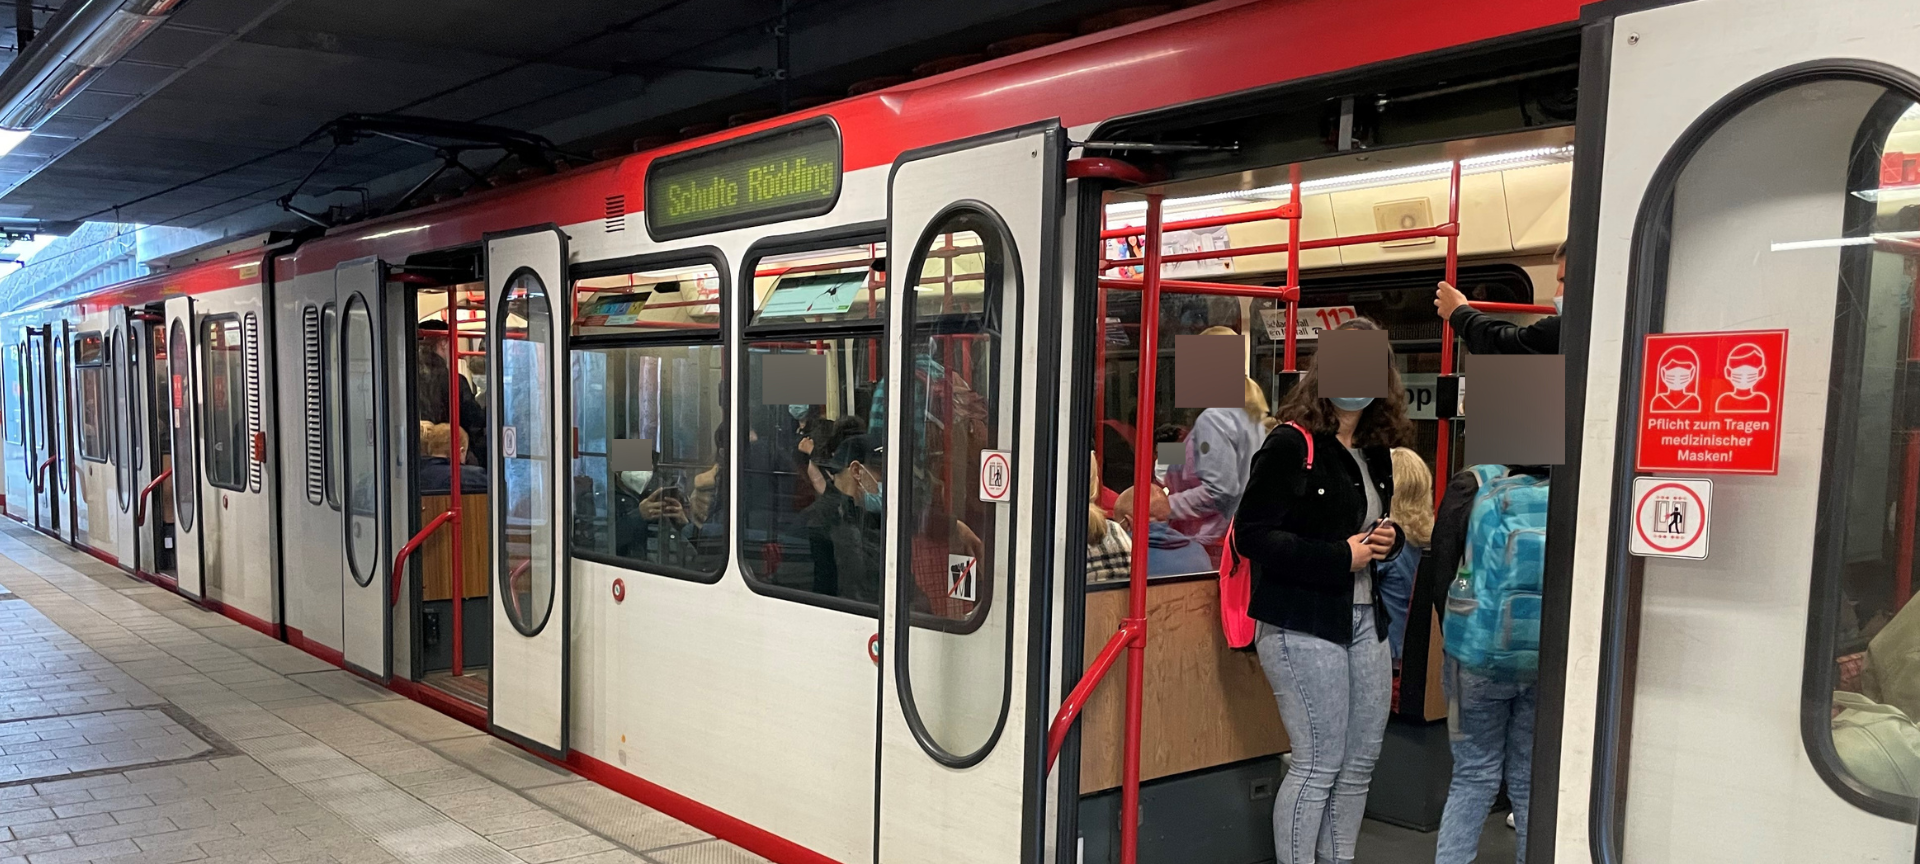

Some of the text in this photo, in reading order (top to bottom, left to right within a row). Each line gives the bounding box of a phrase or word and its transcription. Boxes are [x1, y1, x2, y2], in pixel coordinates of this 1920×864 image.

[668, 157, 834, 216] Schulte Rödding
[1648, 418, 1770, 434] Pflicht zum Tragen
[1661, 434, 1753, 446] medizinischer
[1677, 449, 1733, 462] Masken!
